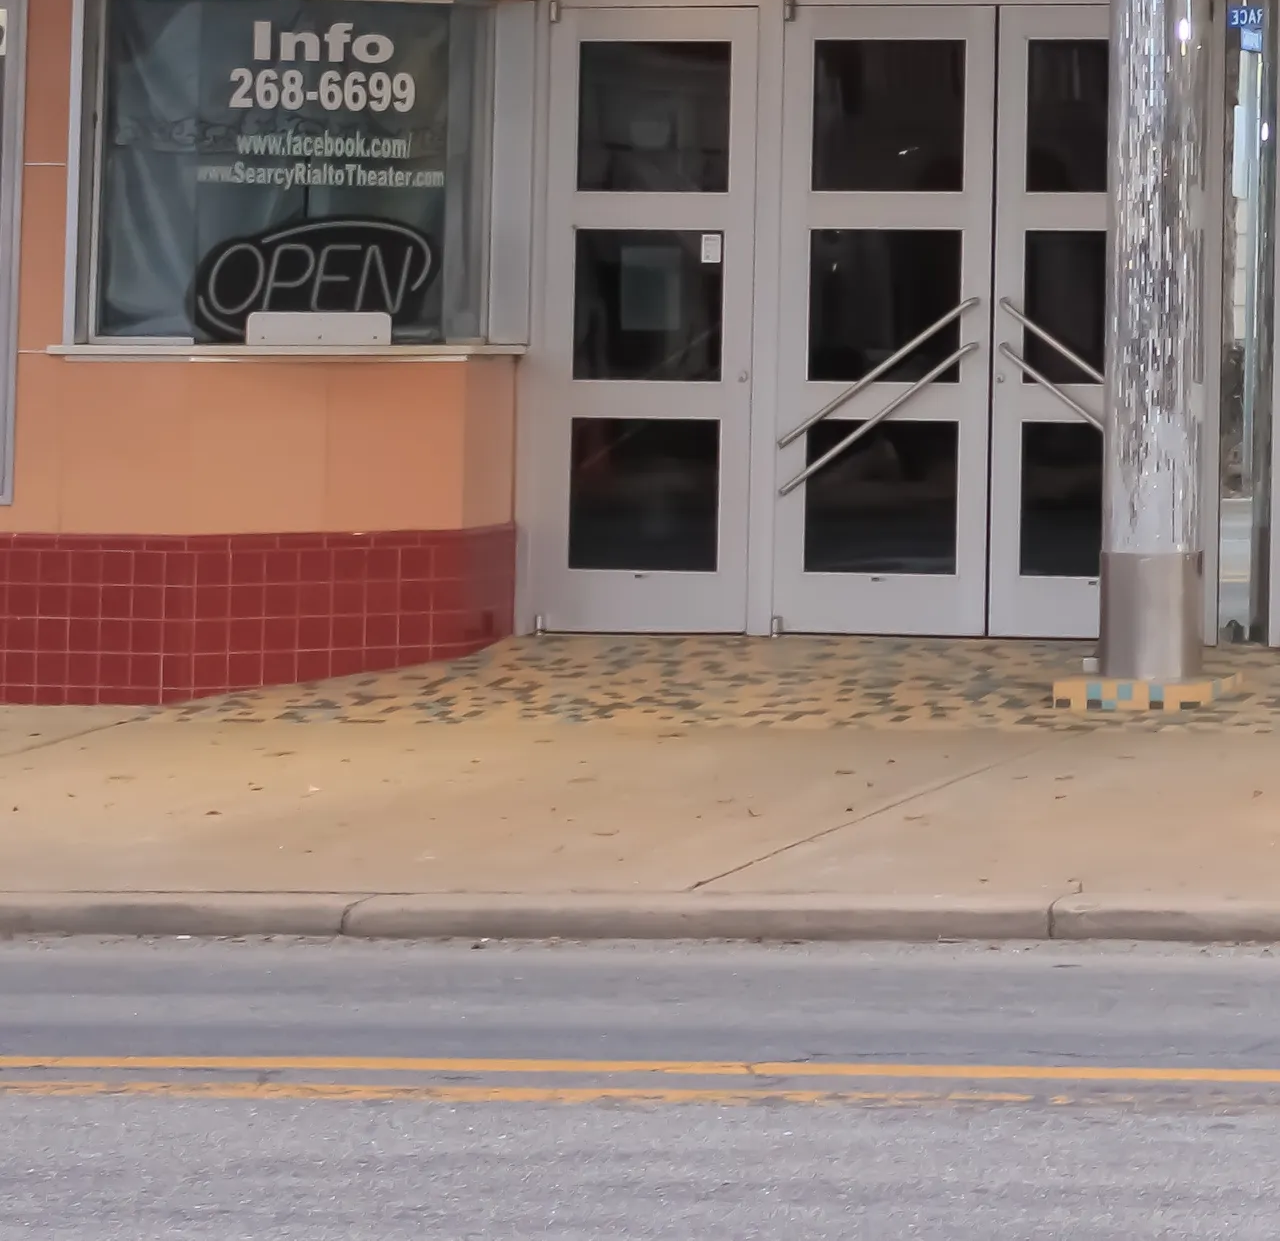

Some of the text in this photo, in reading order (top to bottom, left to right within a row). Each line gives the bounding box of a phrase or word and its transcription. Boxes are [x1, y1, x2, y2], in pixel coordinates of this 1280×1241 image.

[253, 20, 395, 64] Info
[228, 67, 416, 113] 268-6699
[236, 128, 412, 159] www.facebook.com/
[208, 243, 414, 315] OPEN
